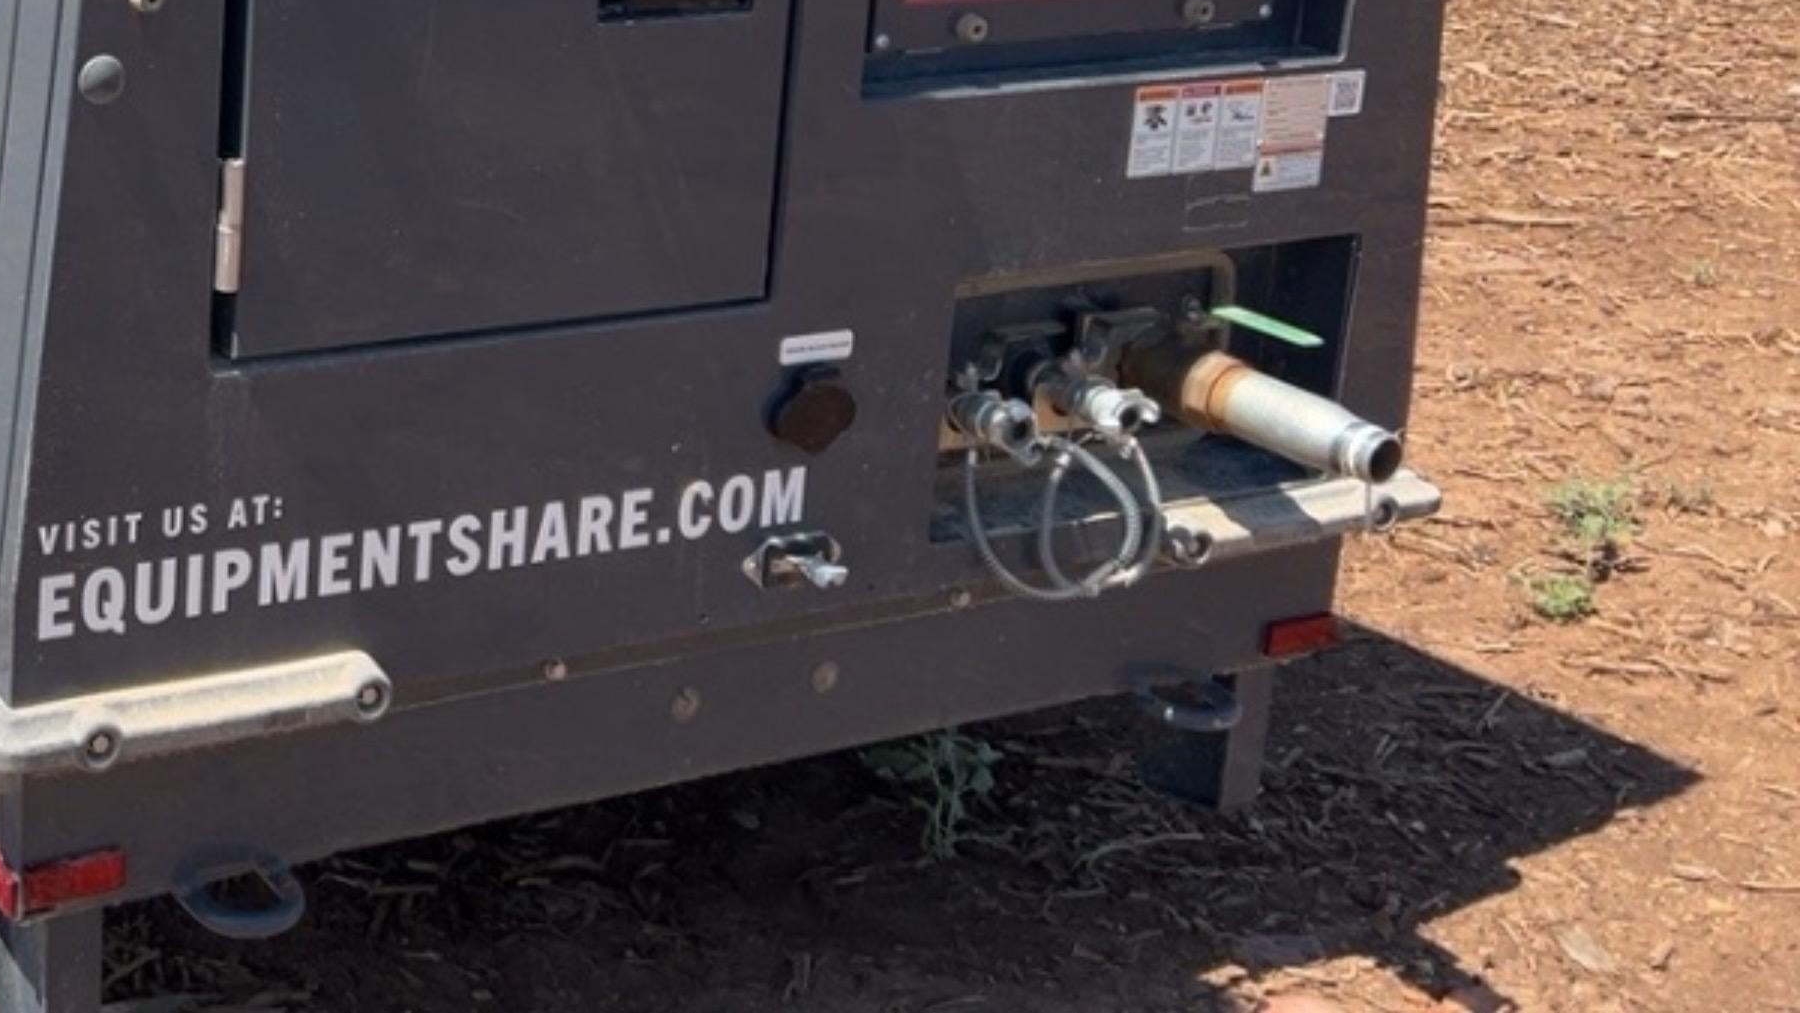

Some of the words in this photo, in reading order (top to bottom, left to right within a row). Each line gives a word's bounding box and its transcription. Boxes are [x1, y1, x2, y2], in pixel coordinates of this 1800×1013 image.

[37, 466, 807, 641] EQUIPMENTSHARE.COM
[38, 512, 143, 556] VISIT
[162, 503, 209, 537] US
[227, 494, 284, 528] AT:
